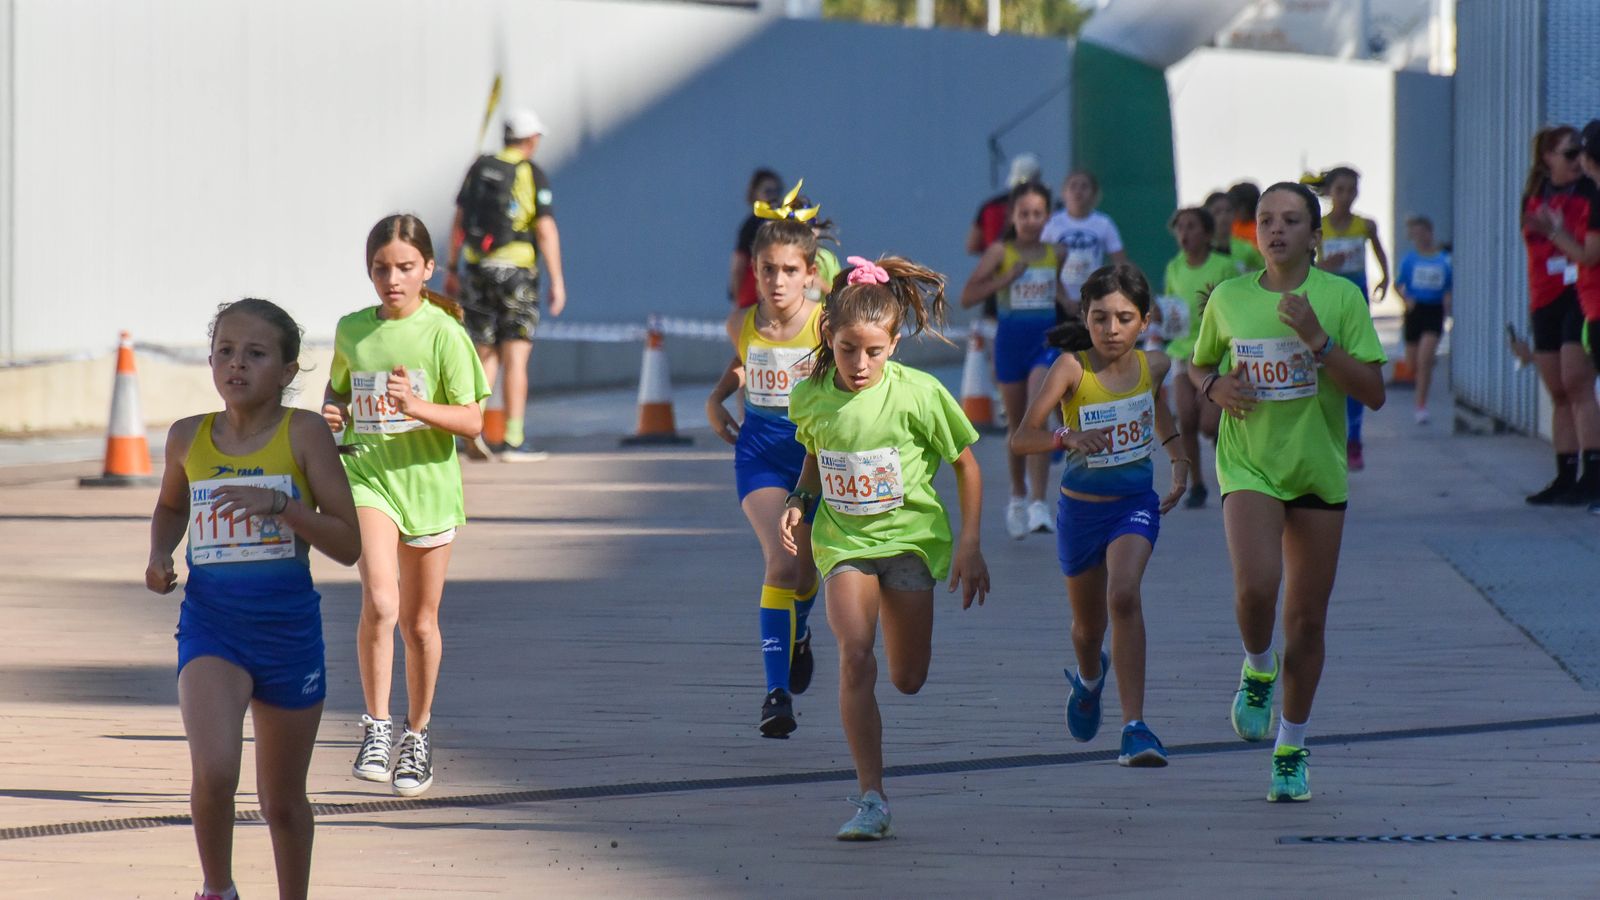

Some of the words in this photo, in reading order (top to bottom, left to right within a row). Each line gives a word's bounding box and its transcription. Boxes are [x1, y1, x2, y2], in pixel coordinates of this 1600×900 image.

[1236, 345, 1249, 354] XXI
[750, 368, 788, 390] 1199
[1240, 361, 1288, 384] 1160
[1084, 410, 1100, 422] XXI
[821, 455, 834, 467] XXI
[193, 487, 207, 502] XXI
[825, 473, 872, 498] 1343
[196, 509, 252, 541] 1111
